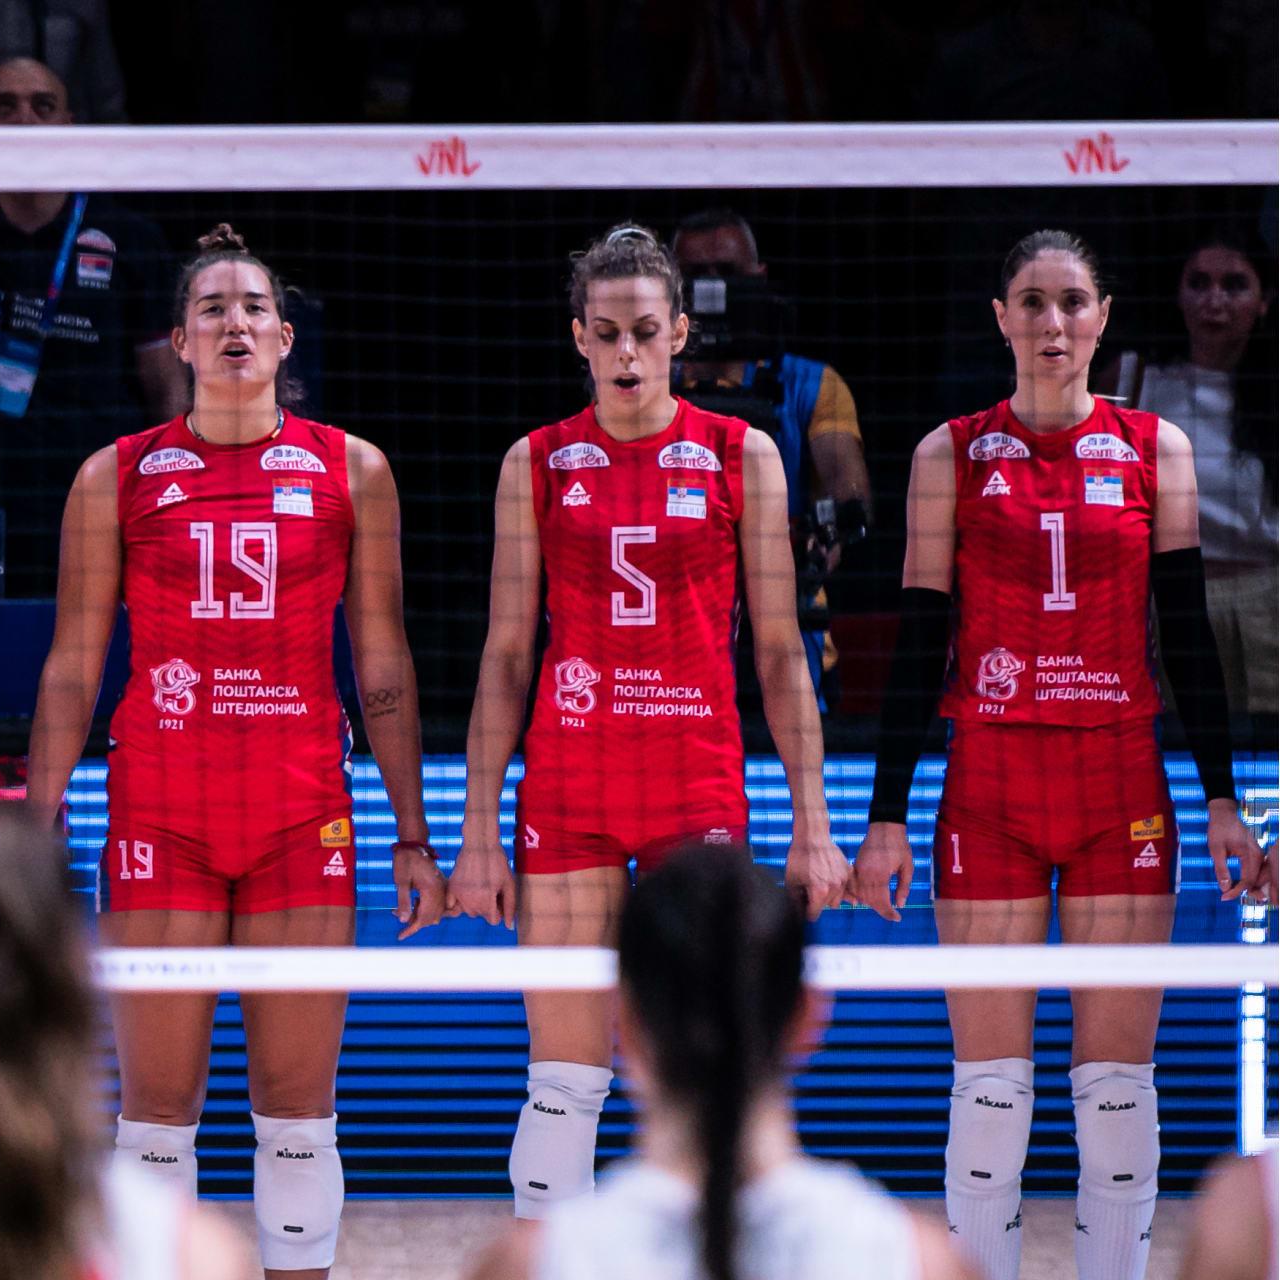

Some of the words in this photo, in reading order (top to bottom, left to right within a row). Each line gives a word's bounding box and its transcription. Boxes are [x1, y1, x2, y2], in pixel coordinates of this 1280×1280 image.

[417, 137, 480, 176] VNL
[1064, 133, 1128, 173] VNL
[983, 485, 1010, 496] PEAK
[563, 494, 591, 506] PEAK
[1041, 512, 1076, 611] 1
[190, 522, 276, 619] 19
[611, 526, 656, 626] 5
[1037, 656, 1083, 667] БАНКА
[214, 669, 261, 680] БАНКА
[615, 668, 662, 681] БАНКА
[1036, 672, 1120, 685] ПОШТАНСКА
[213, 686, 299, 697] ПОШТАНСКА
[614, 685, 702, 699] ПОШТАНСКА
[1035, 688, 1129, 703] ШТЕДИОНИЦА
[212, 702, 307, 715] ШТЕДИОНИЦА
[613, 702, 712, 717] ШТЕДИОНИЦА
[978, 703, 1005, 714] 1921
[159, 719, 184, 729] 1921
[560, 716, 585, 727] 1921
[119, 840, 153, 880] 19
[951, 834, 962, 873] 1
[1134, 856, 1159, 868] PEAK
[323, 866, 346, 876] PEAK
